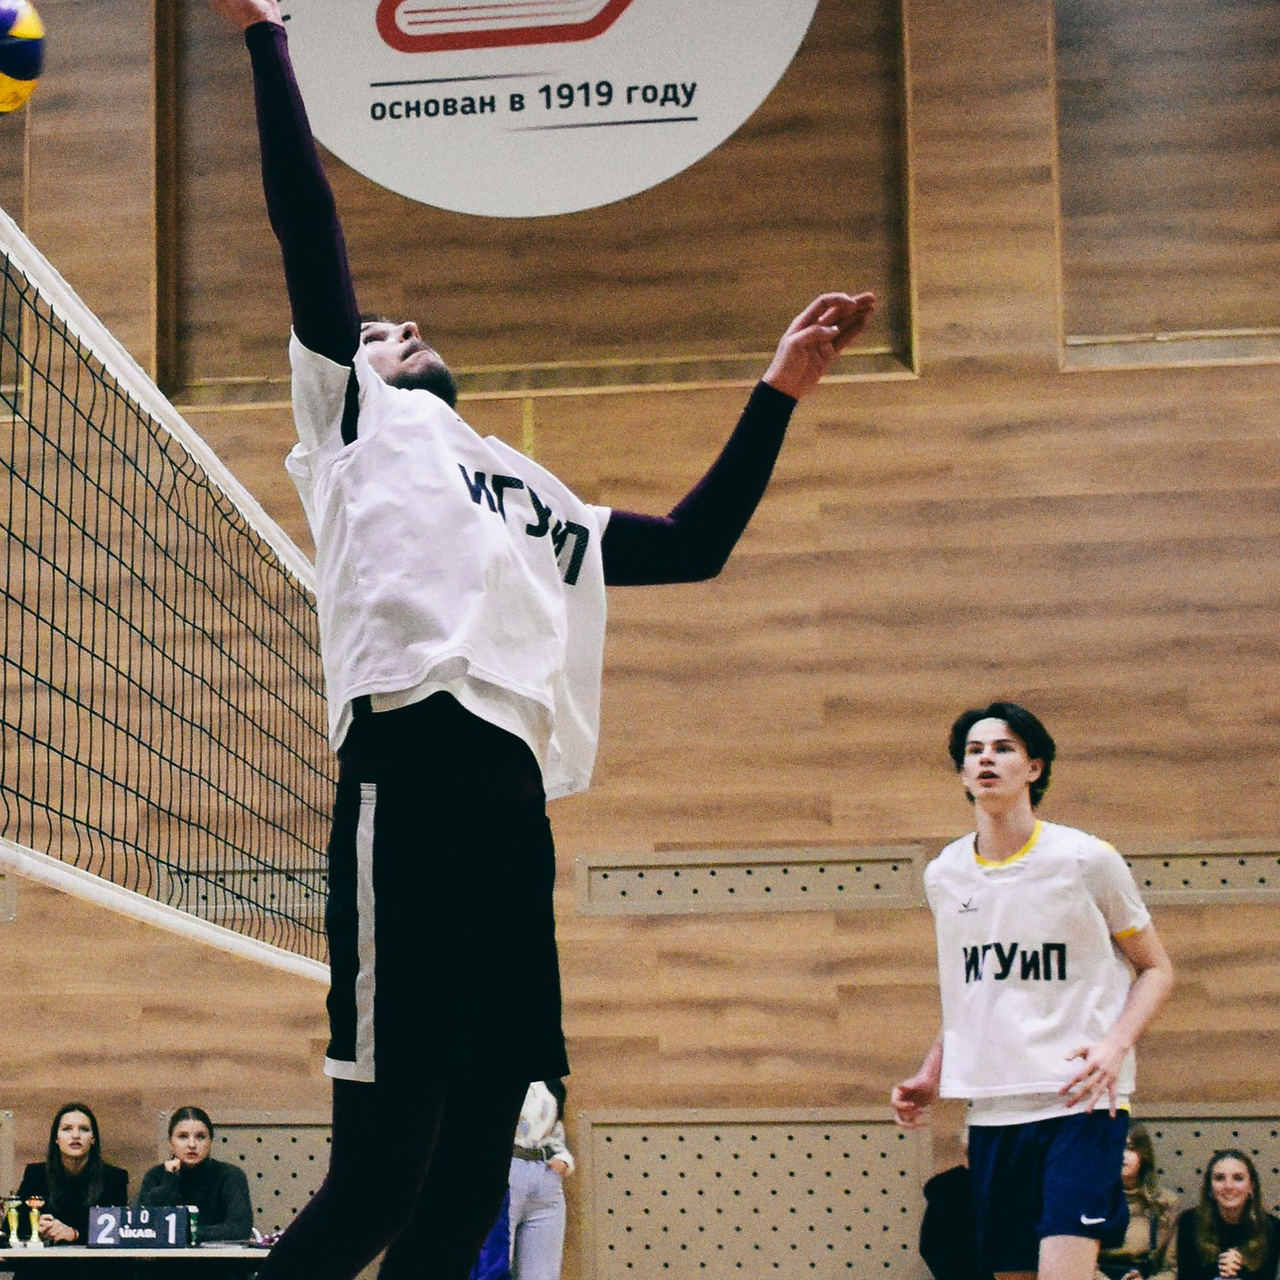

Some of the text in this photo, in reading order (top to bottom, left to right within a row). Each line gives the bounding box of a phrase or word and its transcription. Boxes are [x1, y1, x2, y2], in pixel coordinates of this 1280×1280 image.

[370, 79, 697, 122] основан в 1919 году
[96, 1213, 116, 1244] 2
[126, 1210, 150, 1224] 1 0
[165, 1213, 176, 1245] 1
